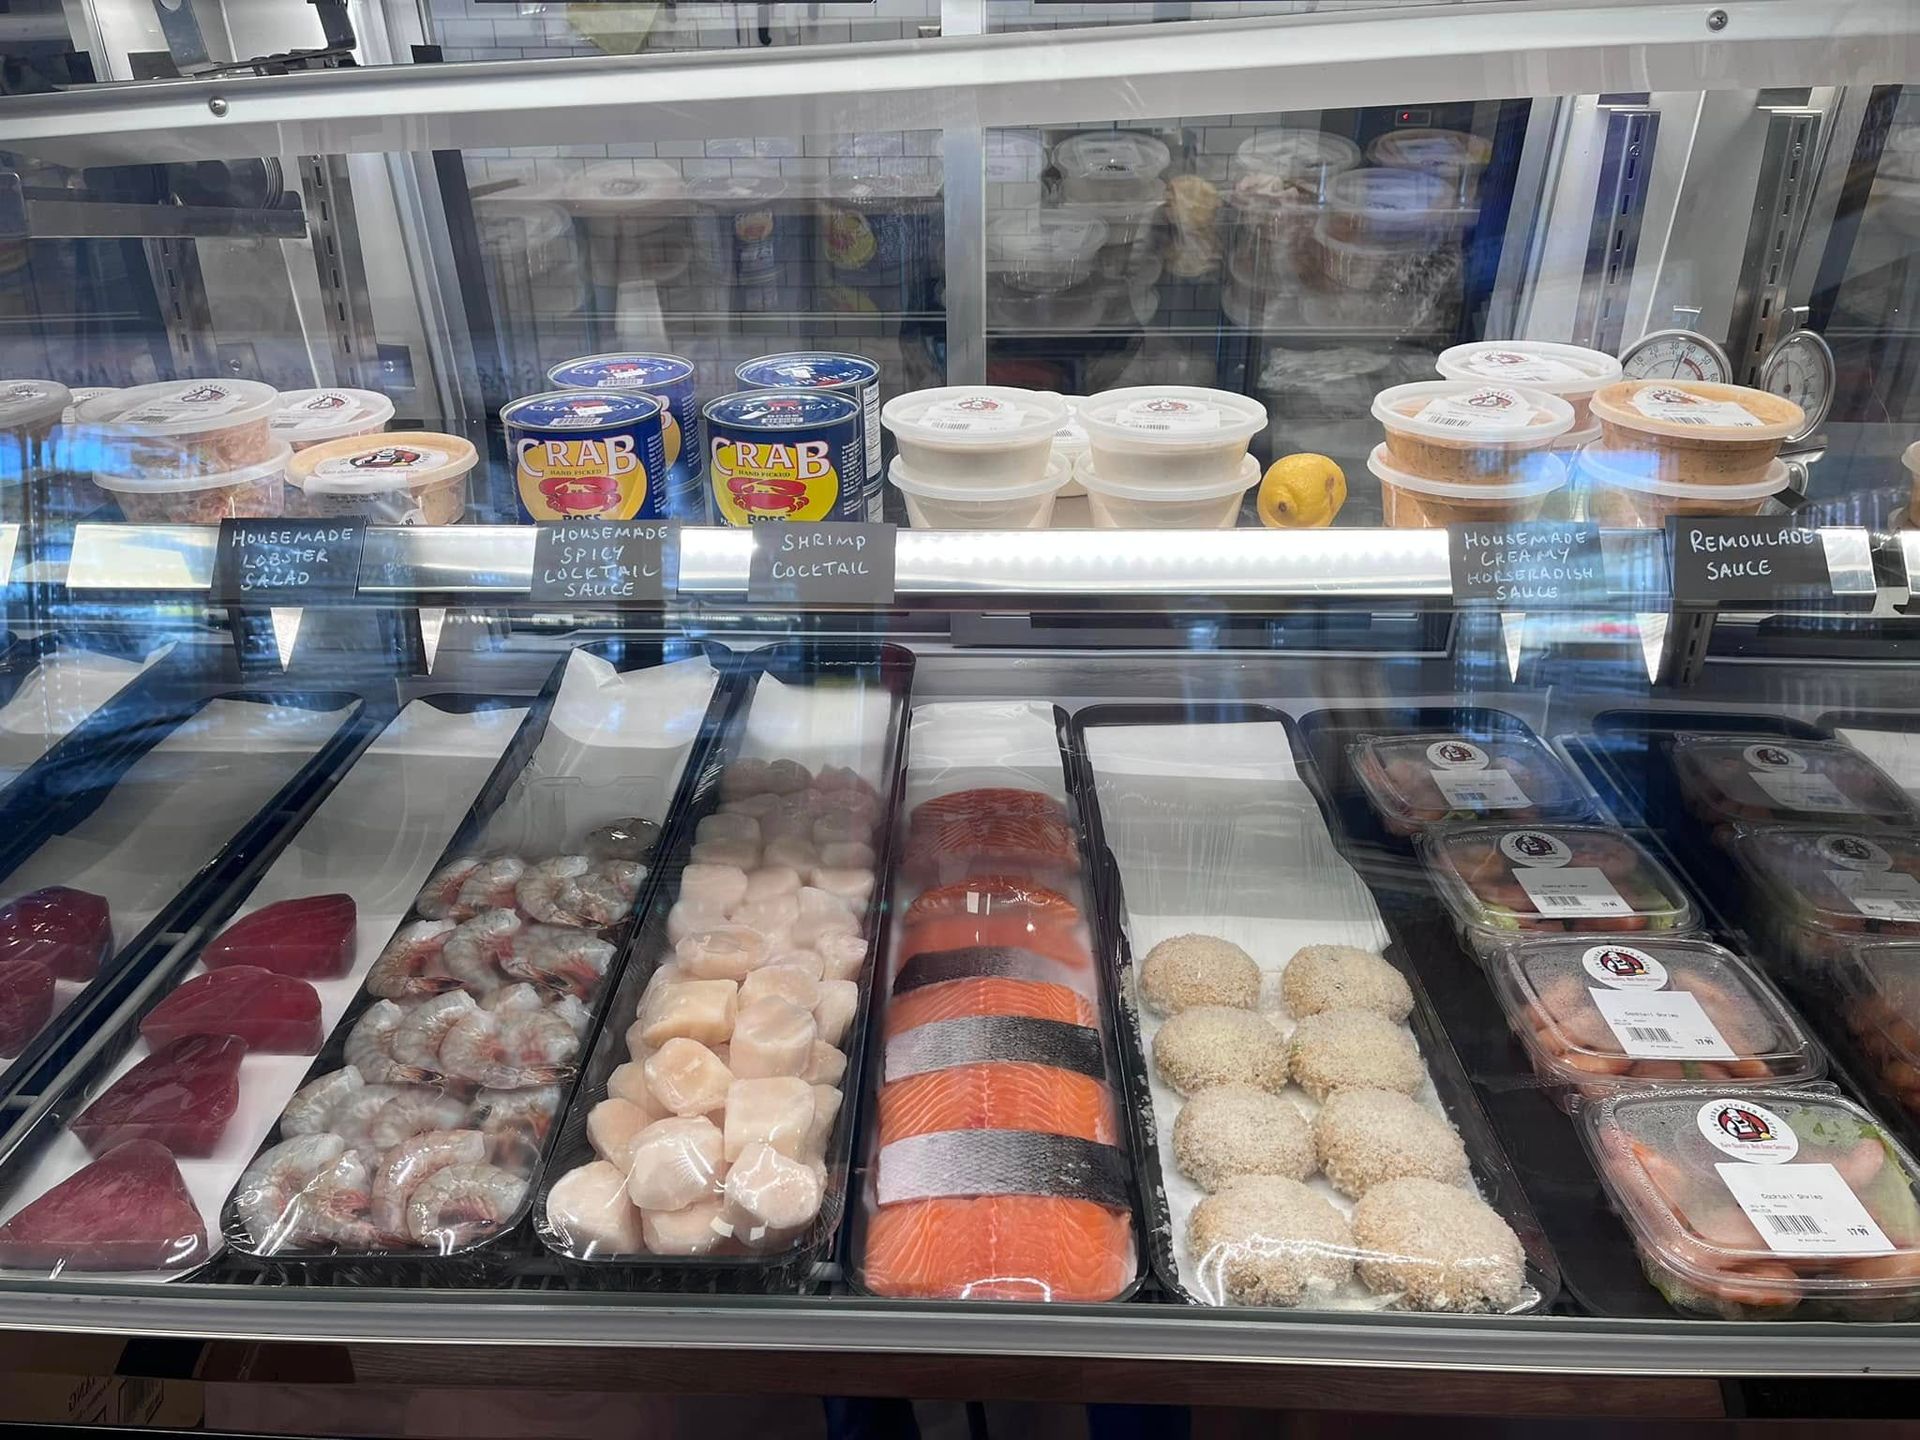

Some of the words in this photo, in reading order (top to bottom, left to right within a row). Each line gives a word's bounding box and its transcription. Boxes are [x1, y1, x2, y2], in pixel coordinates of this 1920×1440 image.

[1670, 342, 1680, 350] 30
[1687, 344, 1696, 353] 40
[516, 434, 638, 477] CRAB
[711, 436, 832, 479] CRAB
[231, 528, 353, 547] HOUSEMADE
[551, 526, 669, 545] HOUSEMADE
[782, 533, 866, 551] SHRIMP
[1464, 531, 1588, 550] HOUSEMADE
[1690, 528, 1814, 553] REMOULADE
[242, 548, 328, 569] LOBSTER
[560, 545, 625, 564] SPICY
[1481, 547, 1570, 567] CREAMY
[544, 563, 660, 584] COCKTAIL
[772, 561, 869, 579] COCKTAIL
[1467, 567, 1593, 585] HORSERADISH
[1706, 559, 1772, 581] SAUCE
[240, 572, 310, 591] SALAD
[564, 582, 634, 597] SAUCE
[1496, 585, 1559, 600] SAUCE
